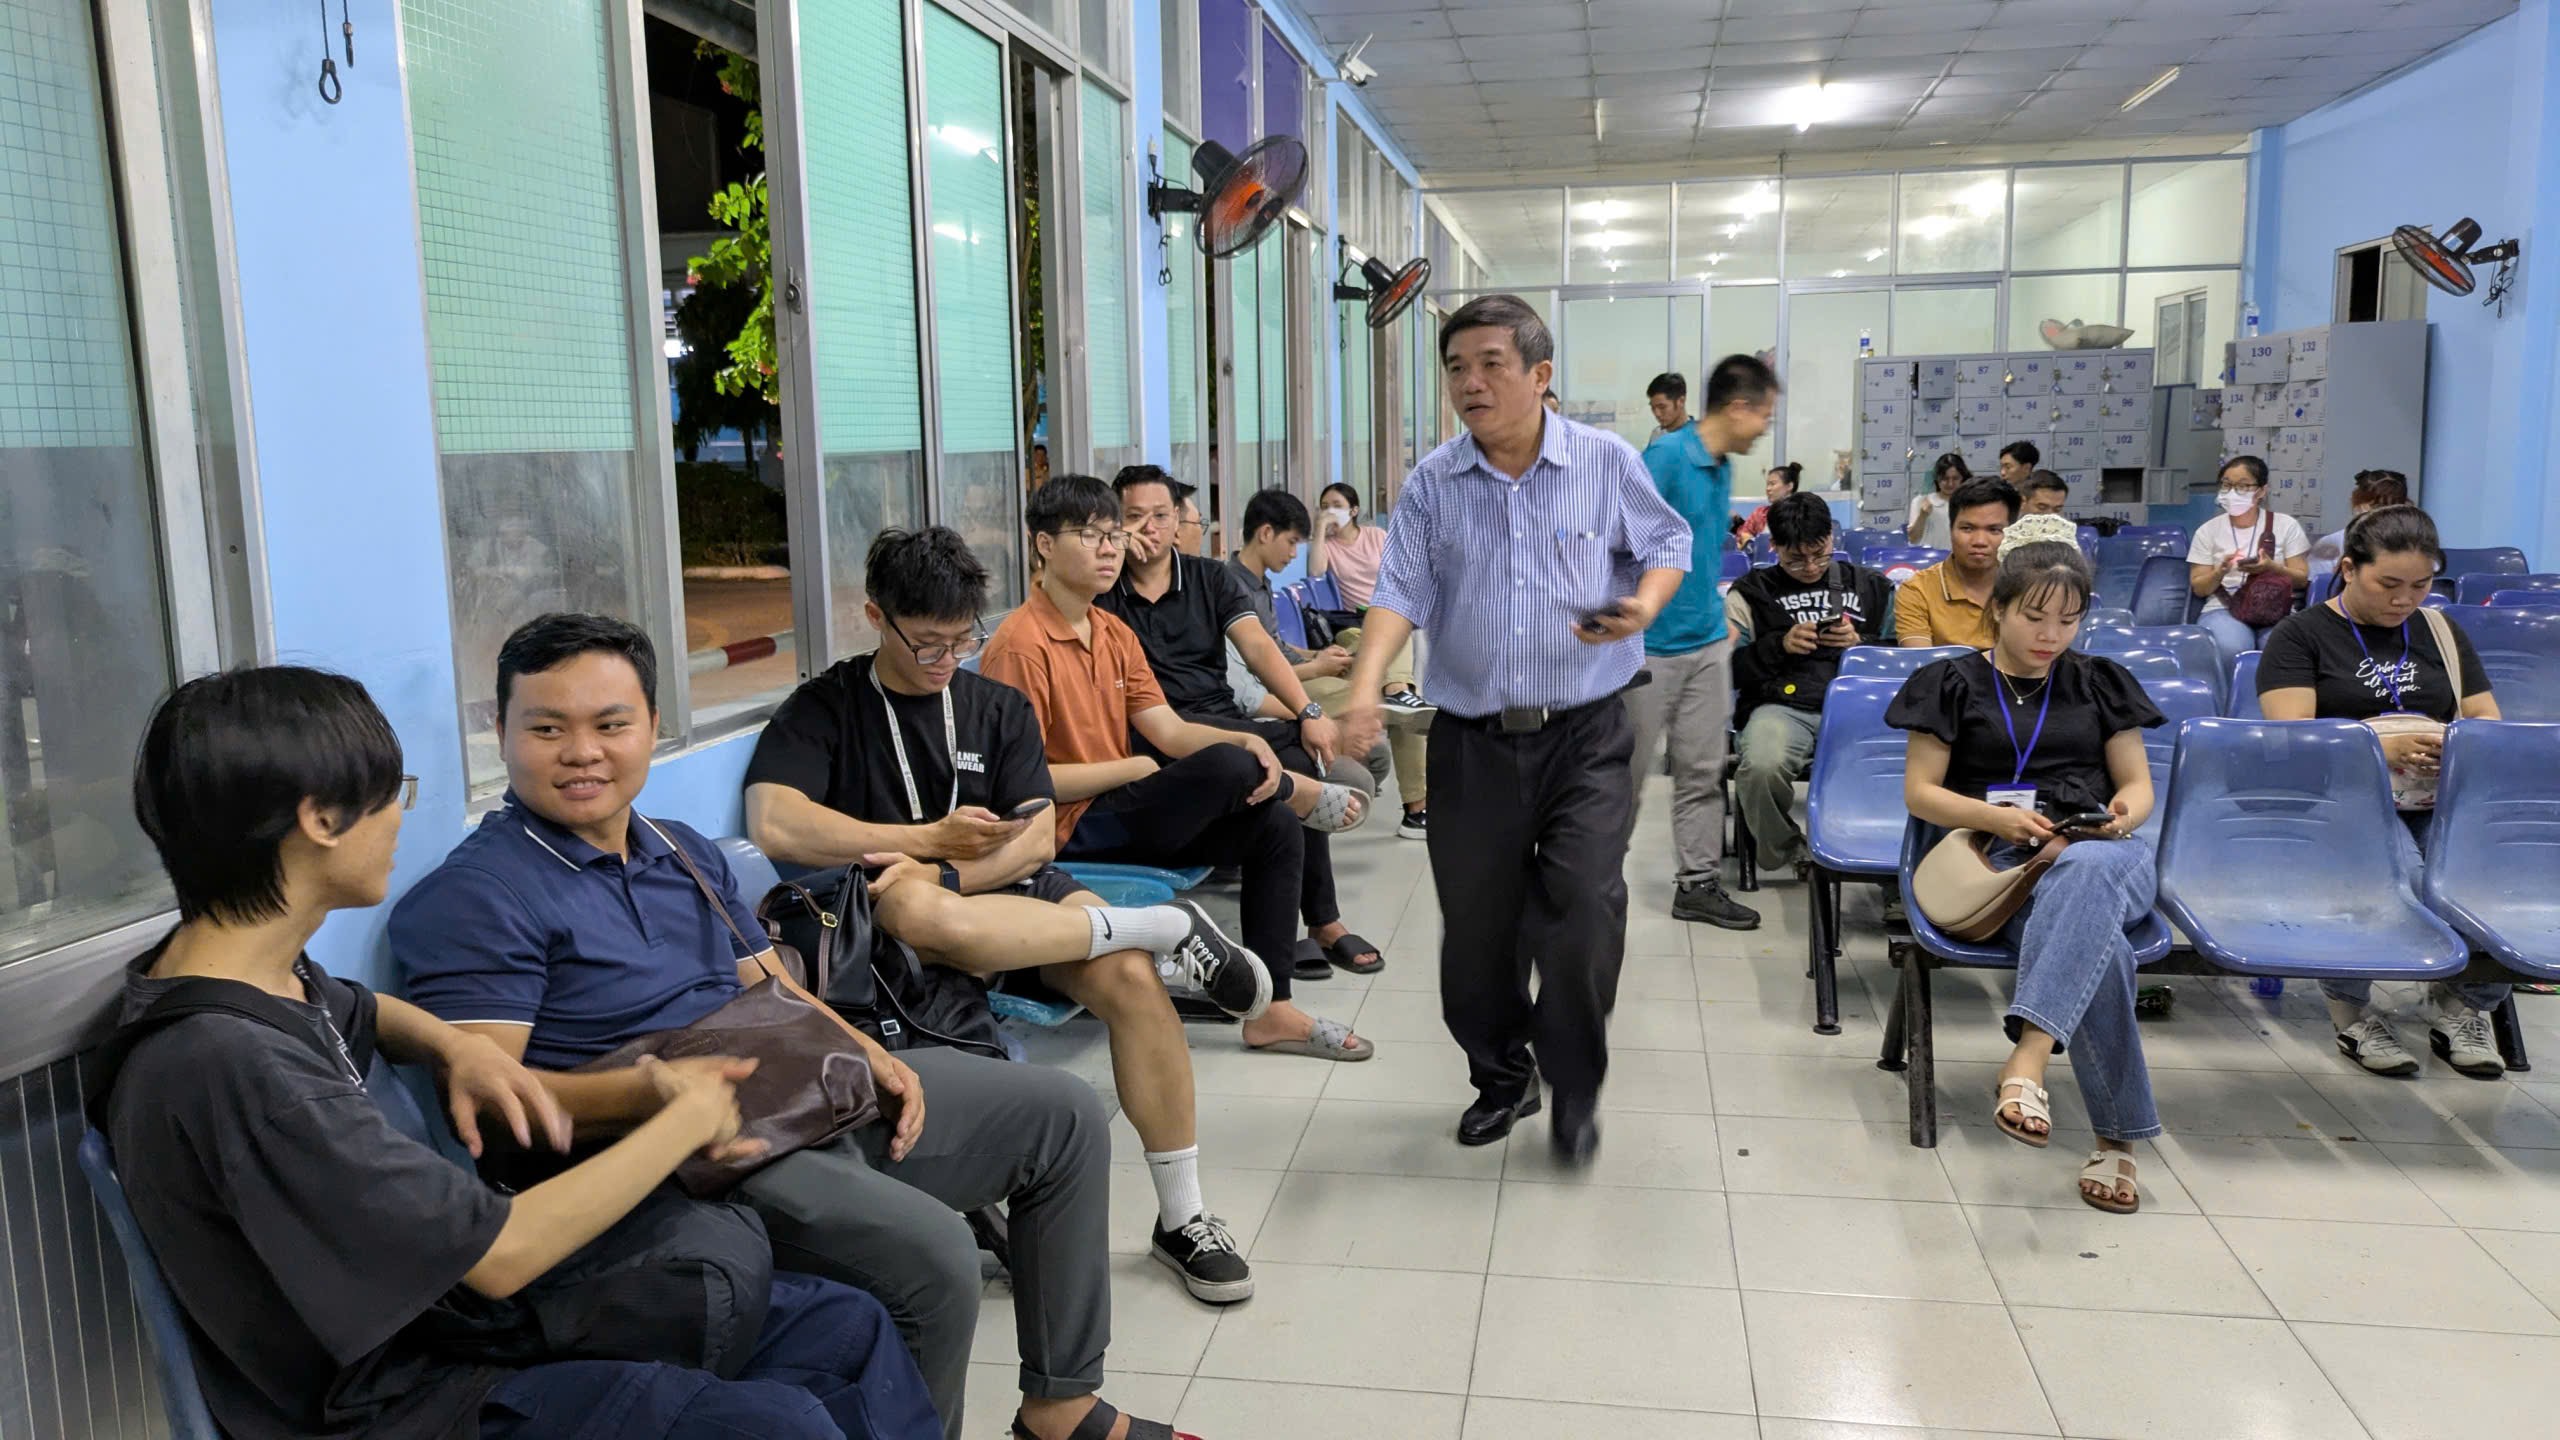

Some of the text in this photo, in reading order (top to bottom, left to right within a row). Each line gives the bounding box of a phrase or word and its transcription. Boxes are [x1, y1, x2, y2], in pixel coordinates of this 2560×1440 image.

[2302, 341, 2316, 353] 132
[2251, 346, 2272, 358] 130
[2027, 363, 2038, 372] 88
[2124, 361, 2136, 370] 90
[1884, 368, 1895, 377] 85
[1978, 366, 1989, 375] 87
[2122, 398, 2134, 407] 96
[2230, 393, 2243, 404] 134
[1978, 403, 1989, 412] 93
[2026, 401, 2037, 410] 94
[2072, 399, 2084, 408] 95
[1883, 405, 1893, 414] 91
[1931, 404, 1941, 413] 92
[2068, 437, 2084, 446] 101
[2116, 435, 2133, 444] 102
[2238, 435, 2255, 445] 141
[1881, 442, 1892, 451] 97
[1929, 440, 1940, 449] 98
[1974, 440, 1986, 449] 99
[2065, 474, 2082, 483] 107
[1877, 479, 1892, 488] 103
[2113, 511, 2130, 520] 114
[1874, 516, 1890, 525] 109
[2355, 657, 2417, 678] Embrce
